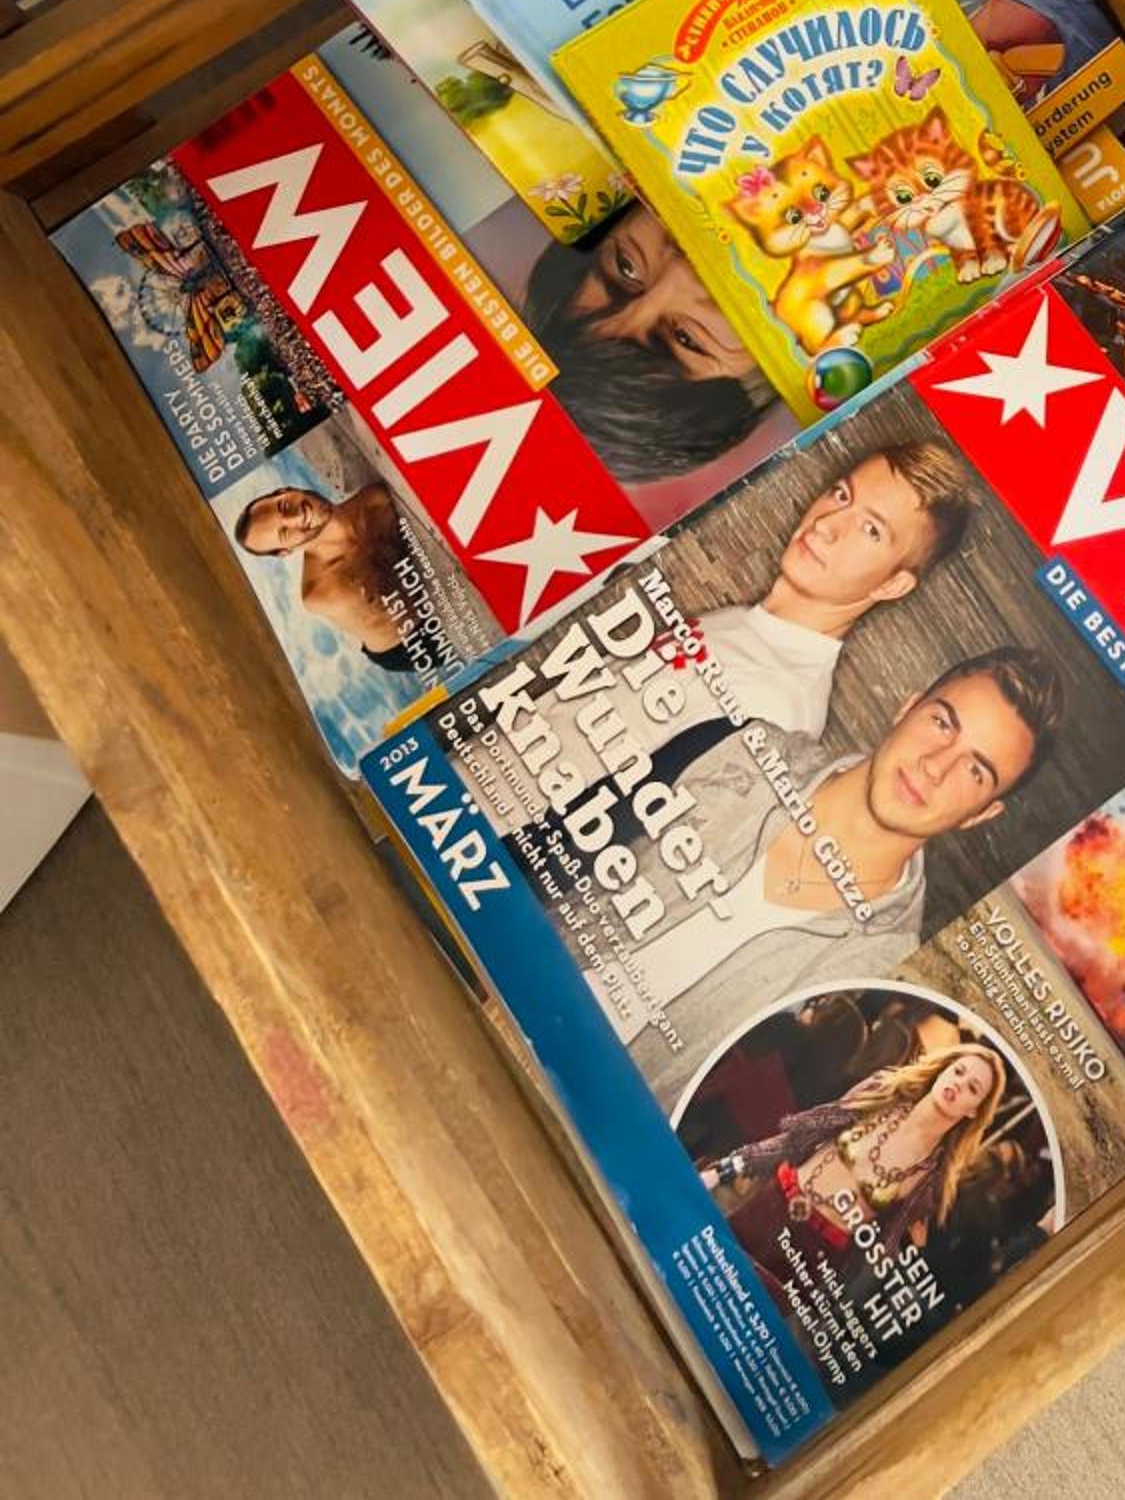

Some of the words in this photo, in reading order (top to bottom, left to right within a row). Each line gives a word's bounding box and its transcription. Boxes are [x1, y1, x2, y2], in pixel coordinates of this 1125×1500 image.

[297, 61, 373, 150] MONATS
[676, 103, 737, 173] ЧТО
[719, 8, 925, 106] СЛУЧИЛОСЬ
[739, 134, 769, 158] У
[758, 58, 883, 133] КОТЯТ?
[362, 145, 404, 191] DES
[392, 185, 460, 263] BILDER
[449, 259, 522, 344] BESTEN
[203, 139, 543, 549] VIEW
[510, 338, 552, 384] DIE
[160, 336, 222, 433] SOMMERS
[162, 385, 209, 450] PARTY
[232, 391, 264, 435] einfach
[236, 370, 284, 442] märchenhaft
[195, 445, 228, 484] DIE
[211, 428, 246, 470] DES
[229, 419, 259, 459] Dieses
[254, 432, 272, 450] ist
[397, 515, 435, 581] Geschichte
[1041, 561, 1090, 614] DIE
[378, 587, 410, 621] IST
[391, 554, 468, 680] UNMÖGLICH
[636, 566, 708, 660] Marco
[392, 617, 445, 692] NICHTS
[583, 585, 705, 729] Die
[693, 653, 753, 730] Reus
[375, 734, 422, 772] 2013
[527, 618, 760, 934] Wunder-
[739, 726, 771, 758] &
[475, 658, 688, 943] knaben
[752, 744, 824, 838] Mario
[386, 754, 514, 913] MÄRZ
[435, 710, 513, 818] Deutschland
[508, 823, 549, 872] nicht
[536, 868, 566, 903] nur
[555, 899, 587, 935] auf
[573, 928, 612, 974] dem
[596, 967, 641, 1021] Platz
[456, 695, 491, 734] Das
[478, 727, 556, 835] Dortmunder
[540, 827, 607, 916] Spaß-Duo
[591, 910, 667, 1013] verzaubert
[648, 1009, 687, 1055] ganz
[807, 829, 882, 926] Götze
[952, 933, 971, 953] so
[960, 948, 1003, 998] richtig
[966, 920, 992, 948] Ein
[979, 944, 1036, 1013] Stuntman
[1045, 1043, 1065, 1065] es
[1056, 1058, 1086, 1091] mal
[983, 905, 1055, 1003] VOLLES
[1042, 997, 1109, 1081] RISIKO
[991, 993, 1040, 1053] krachen
[697, 1223, 752, 1303] Deutschland
[828, 1184, 926, 1328] GRÖSSTER
[893, 1243, 948, 1311] SEIN
[771, 1226, 819, 1288] Tochter
[806, 1285, 849, 1341] stürmt
[837, 1337, 868, 1373] den
[779, 1278, 849, 1387] Model-Olymp
[813, 1257, 848, 1301] Mick
[833, 1296, 884, 1362] Jaggers
[858, 1291, 904, 1345] HIT
